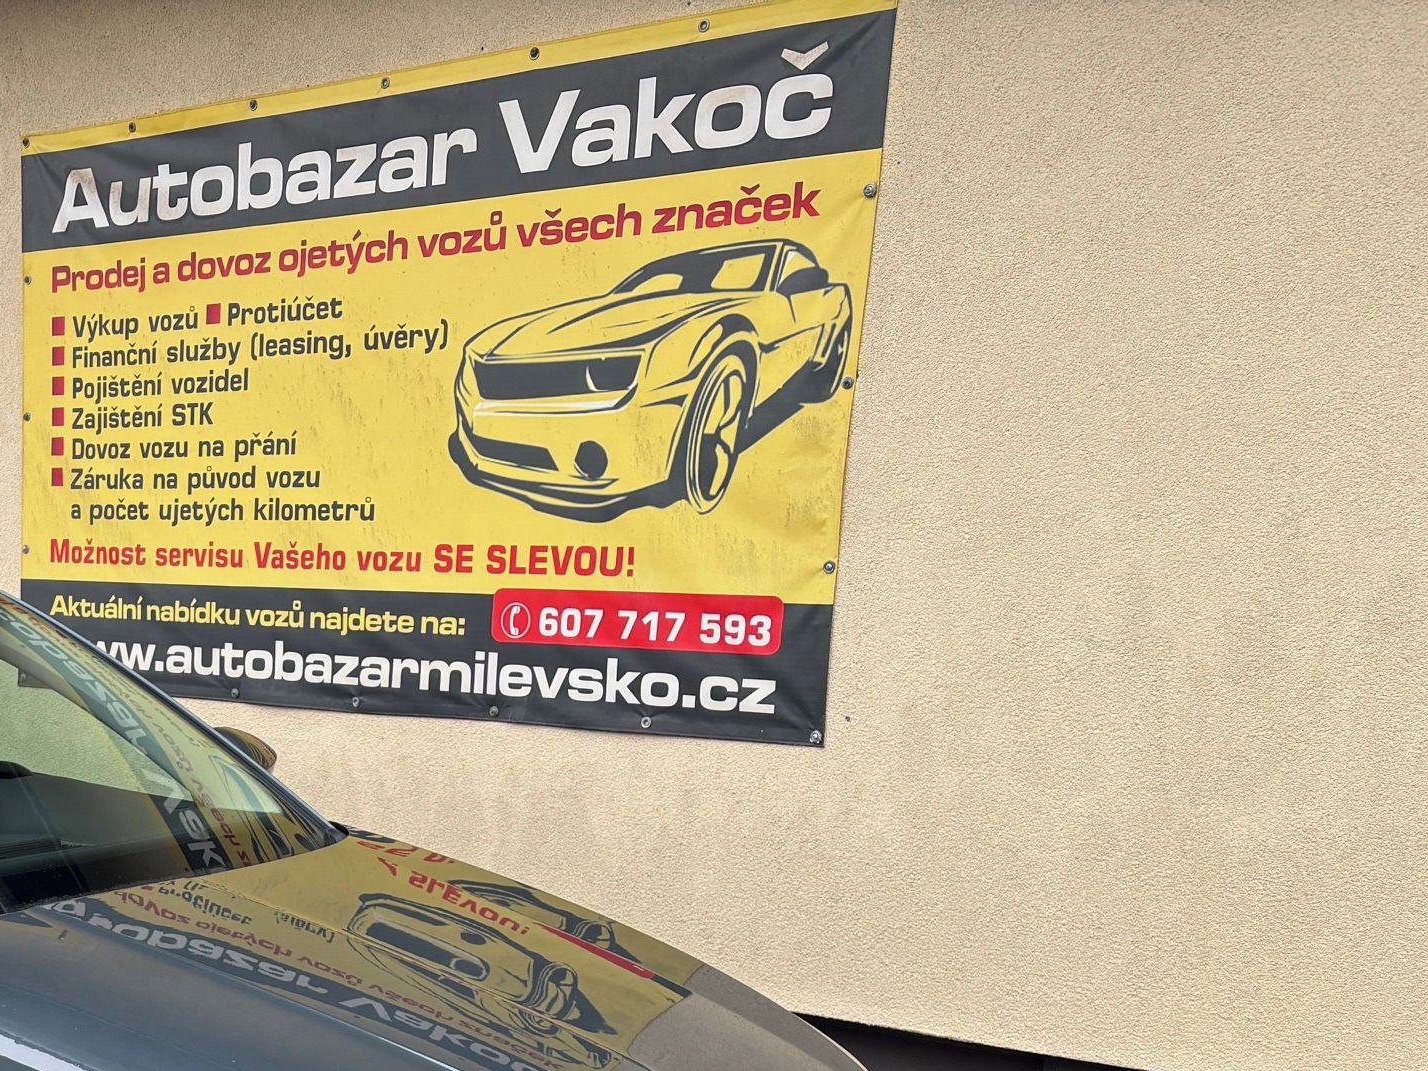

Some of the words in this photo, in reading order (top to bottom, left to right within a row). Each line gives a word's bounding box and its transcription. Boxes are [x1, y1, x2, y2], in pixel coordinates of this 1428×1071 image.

[52, 127, 478, 233] Autobazar
[498, 41, 834, 174] Vakoč
[51, 256, 146, 293] Prodej
[152, 261, 170, 284] a
[177, 250, 271, 282] dovoz
[278, 229, 409, 278] ojetých
[417, 210, 507, 256] vozů
[516, 203, 643, 247] všech
[651, 181, 822, 235] značek
[72, 314, 139, 343] Výkup
[148, 305, 199, 332] vozů
[227, 296, 343, 327] Protiúčet
[72, 341, 157, 369] Finanční
[166, 337, 241, 366] služby
[250, 330, 352, 361] (leasing,
[363, 318, 449, 353] úvěry)
[72, 372, 162, 404] Pojištění
[171, 367, 249, 394] vozidel
[72, 403, 163, 434] Zajištění
[171, 401, 214, 426] STK
[71, 437, 131, 460] Dovoz
[140, 439, 189, 459] vozu
[198, 438, 224, 457] na
[234, 430, 297, 462] přání
[71, 467, 144, 490] Záruka
[153, 471, 178, 489] na
[187, 465, 257, 495] původ
[267, 468, 321, 488] vozu
[71, 502, 82, 520] a
[89, 498, 150, 525] počet
[159, 497, 244, 527] ujetých
[253, 496, 376, 522] kilometrů
[49, 538, 149, 567] Možnost
[155, 543, 244, 569] servisu
[253, 541, 347, 572] Vašeho
[356, 549, 422, 573] vozu
[433, 543, 474, 574] SE
[486, 544, 636, 577] SLEVOU!
[49, 594, 142, 621] Aktuální
[146, 598, 241, 626] nabídku
[245, 600, 304, 628] vozů
[310, 607, 415, 635] najdete
[421, 612, 466, 636] na:
[538, 606, 604, 638] 607
[617, 609, 686, 642] 717
[699, 613, 772, 647] 593
[95, 640, 776, 715] w.autobazarmilevsko.cz
